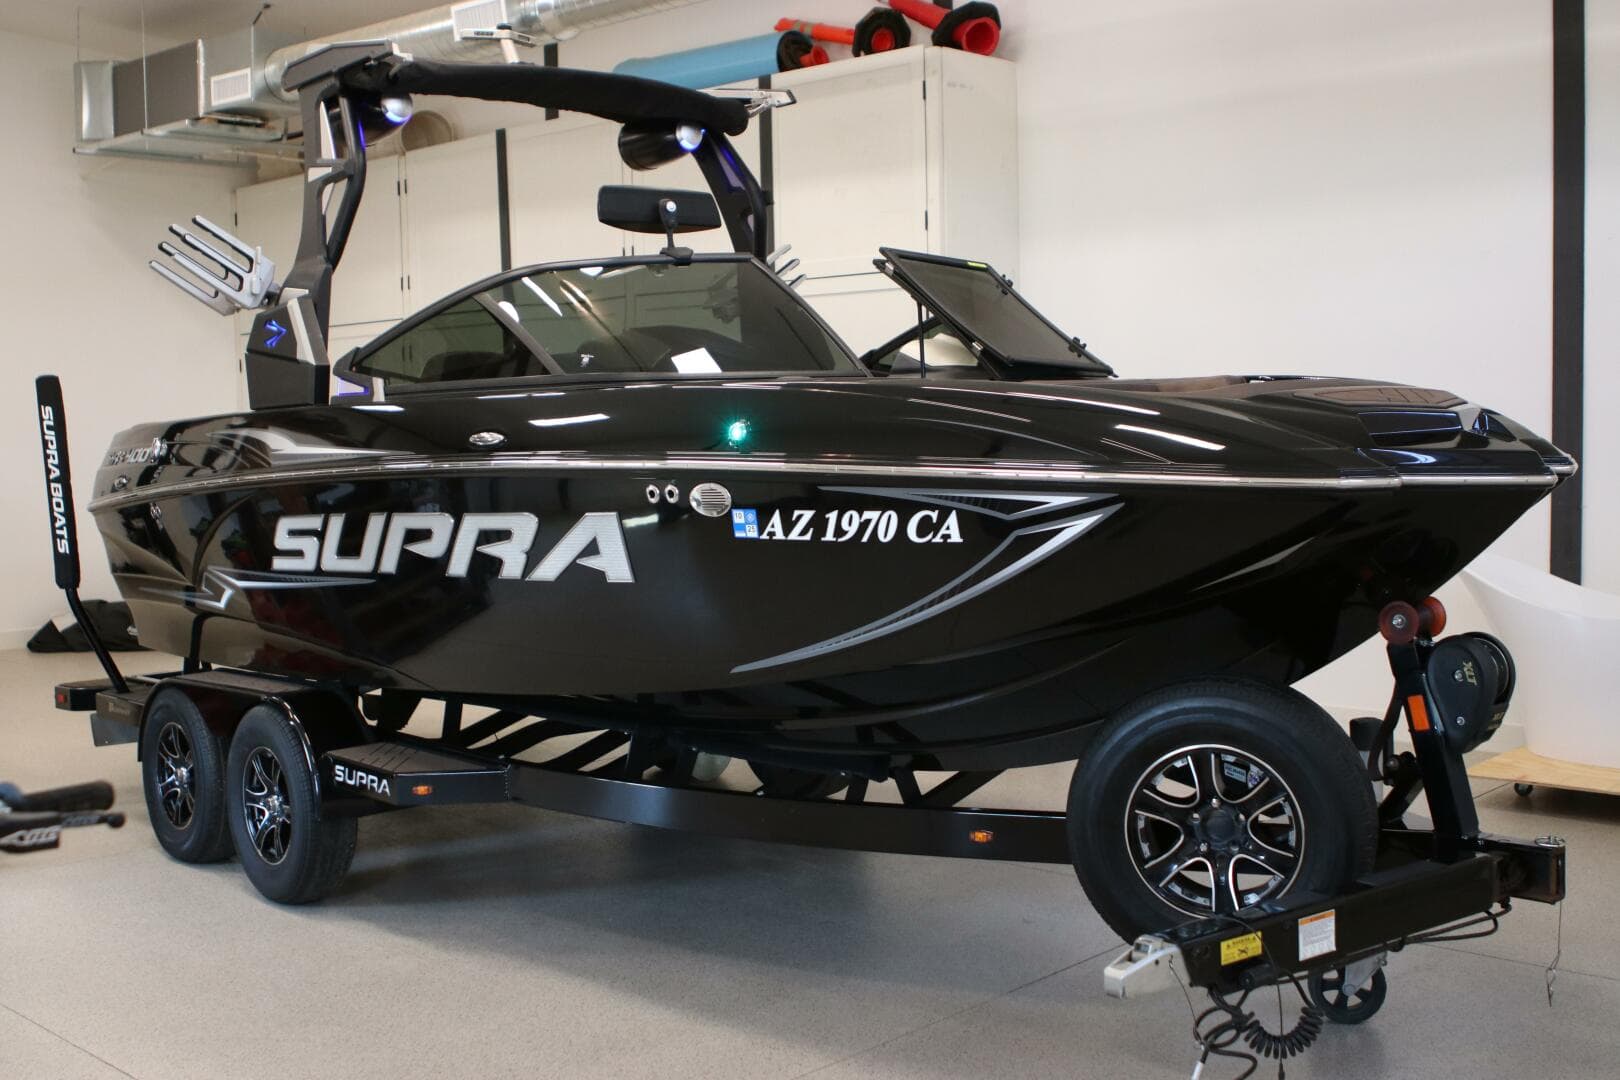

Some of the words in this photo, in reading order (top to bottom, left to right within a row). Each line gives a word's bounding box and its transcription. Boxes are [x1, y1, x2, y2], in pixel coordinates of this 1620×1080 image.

[41, 404, 61, 479] SUPRA
[51, 483, 69, 554] BOATS
[271, 512, 635, 583] SUPRA
[759, 508, 816, 541] AZ
[821, 509, 899, 543] 1970
[906, 509, 963, 543] CA
[335, 764, 391, 797] SUPRA
